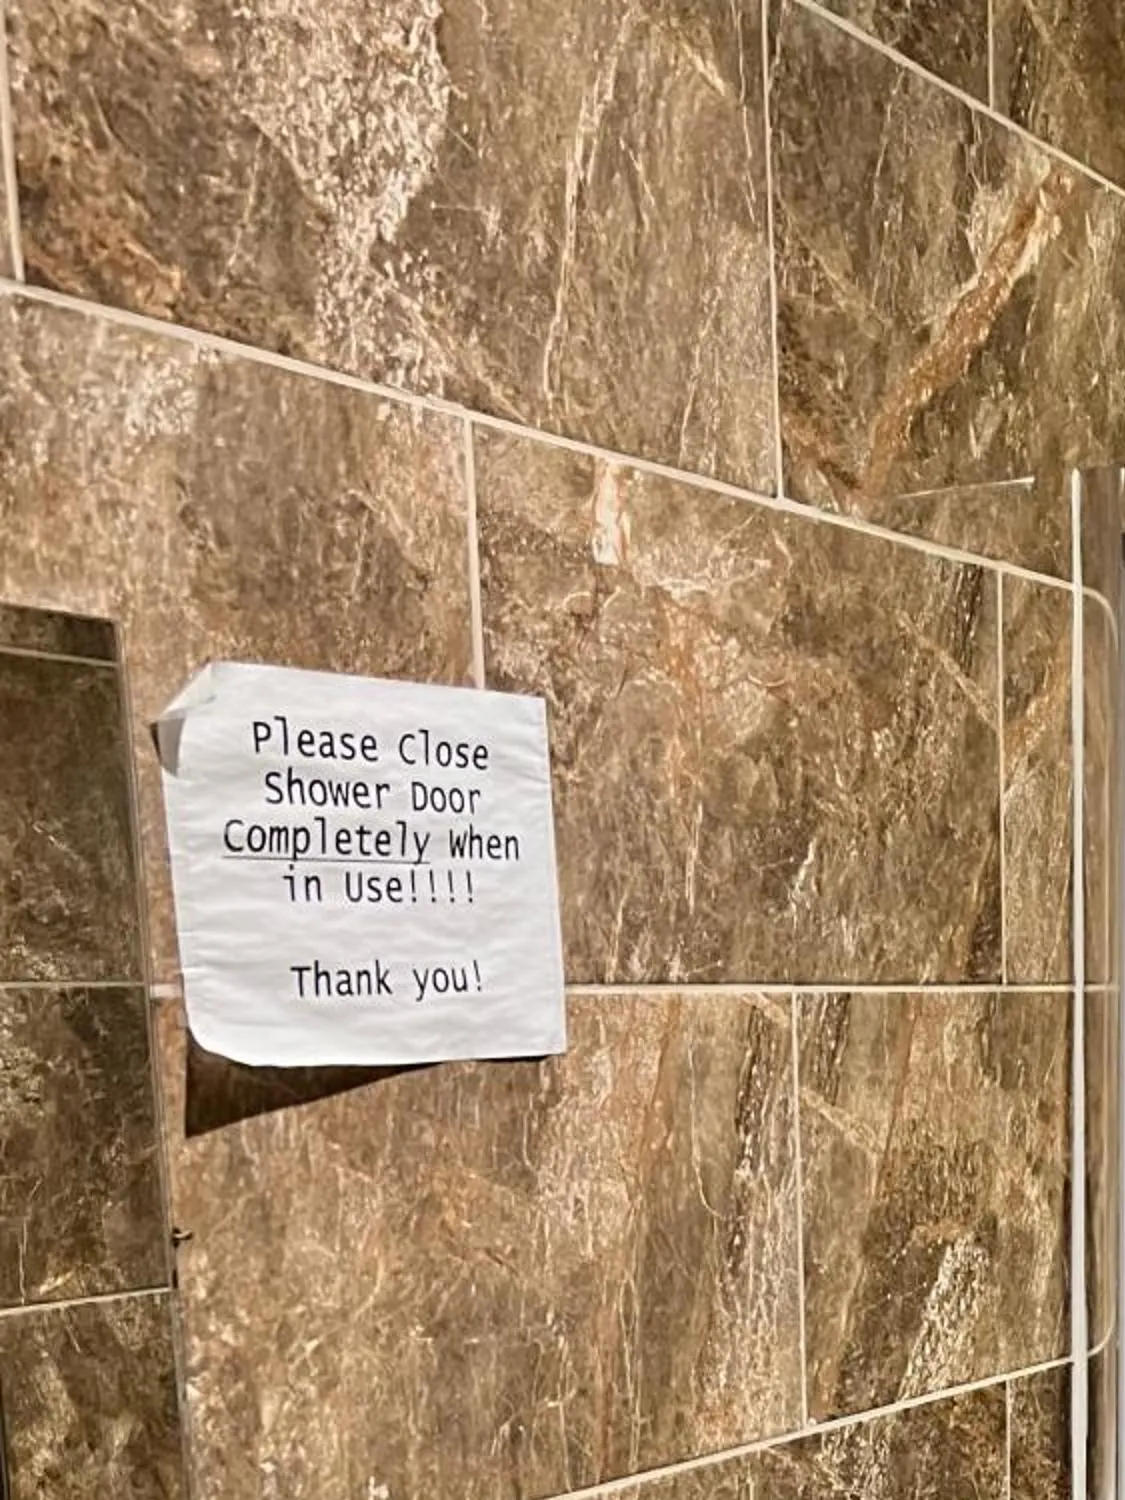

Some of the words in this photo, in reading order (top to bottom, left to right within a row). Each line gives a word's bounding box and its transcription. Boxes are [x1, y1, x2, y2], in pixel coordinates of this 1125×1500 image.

[251, 715, 379, 763] Please
[398, 729, 490, 771] Close
[264, 766, 391, 809] Shower
[411, 781, 482, 815] Door
[223, 816, 432, 865] Completely
[448, 823, 521, 861] When
[282, 864, 323, 903] in
[345, 869, 475, 904] Use!!!!
[289, 959, 394, 998] Thank
[412, 959, 483, 1003] you!
